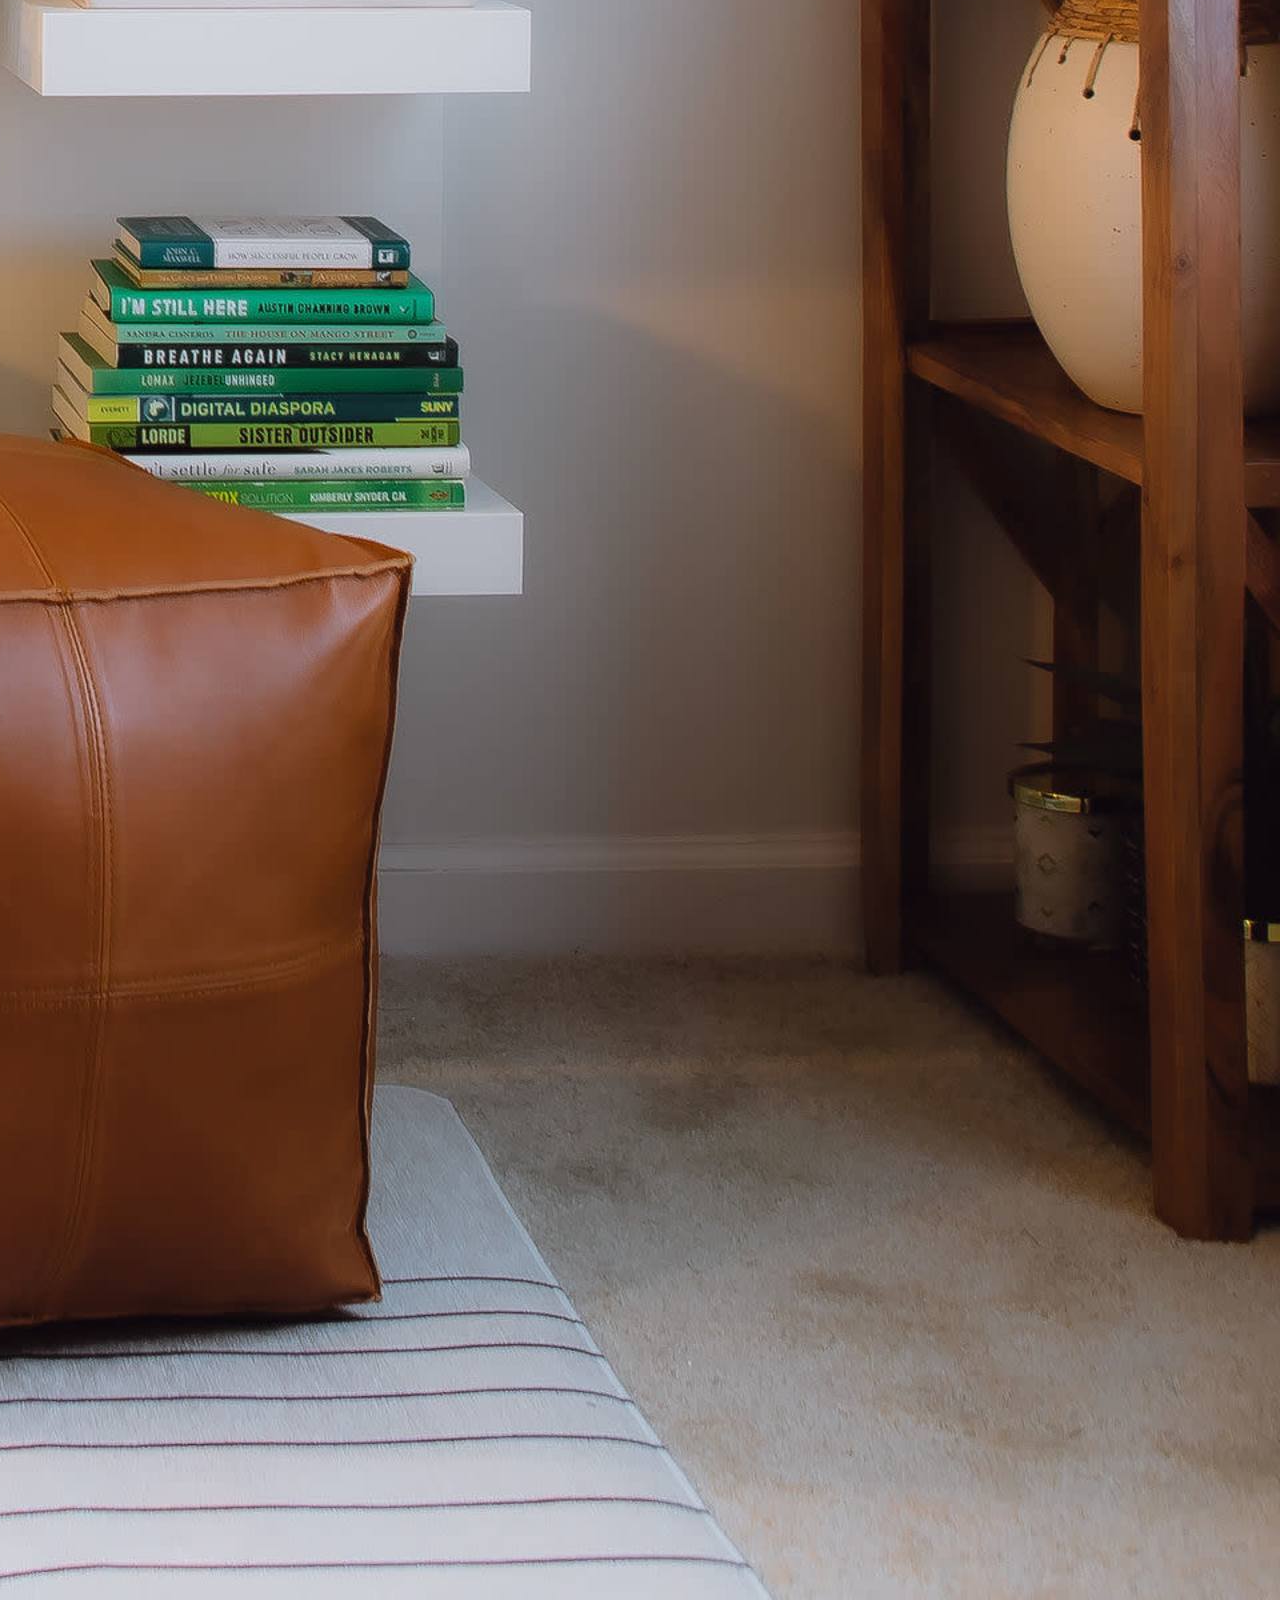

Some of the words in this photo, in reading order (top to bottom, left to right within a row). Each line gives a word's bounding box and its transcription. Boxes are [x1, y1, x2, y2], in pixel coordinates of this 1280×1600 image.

[121, 300, 145, 316] I'M
[152, 300, 198, 317] STILL
[204, 300, 247, 317] HERE
[181, 402, 245, 417] DIGITAL
[250, 401, 336, 416] DIASPORA
[142, 428, 186, 444] LORDE
[240, 428, 294, 444] SISTER
[300, 428, 374, 443] OUTSIDER
